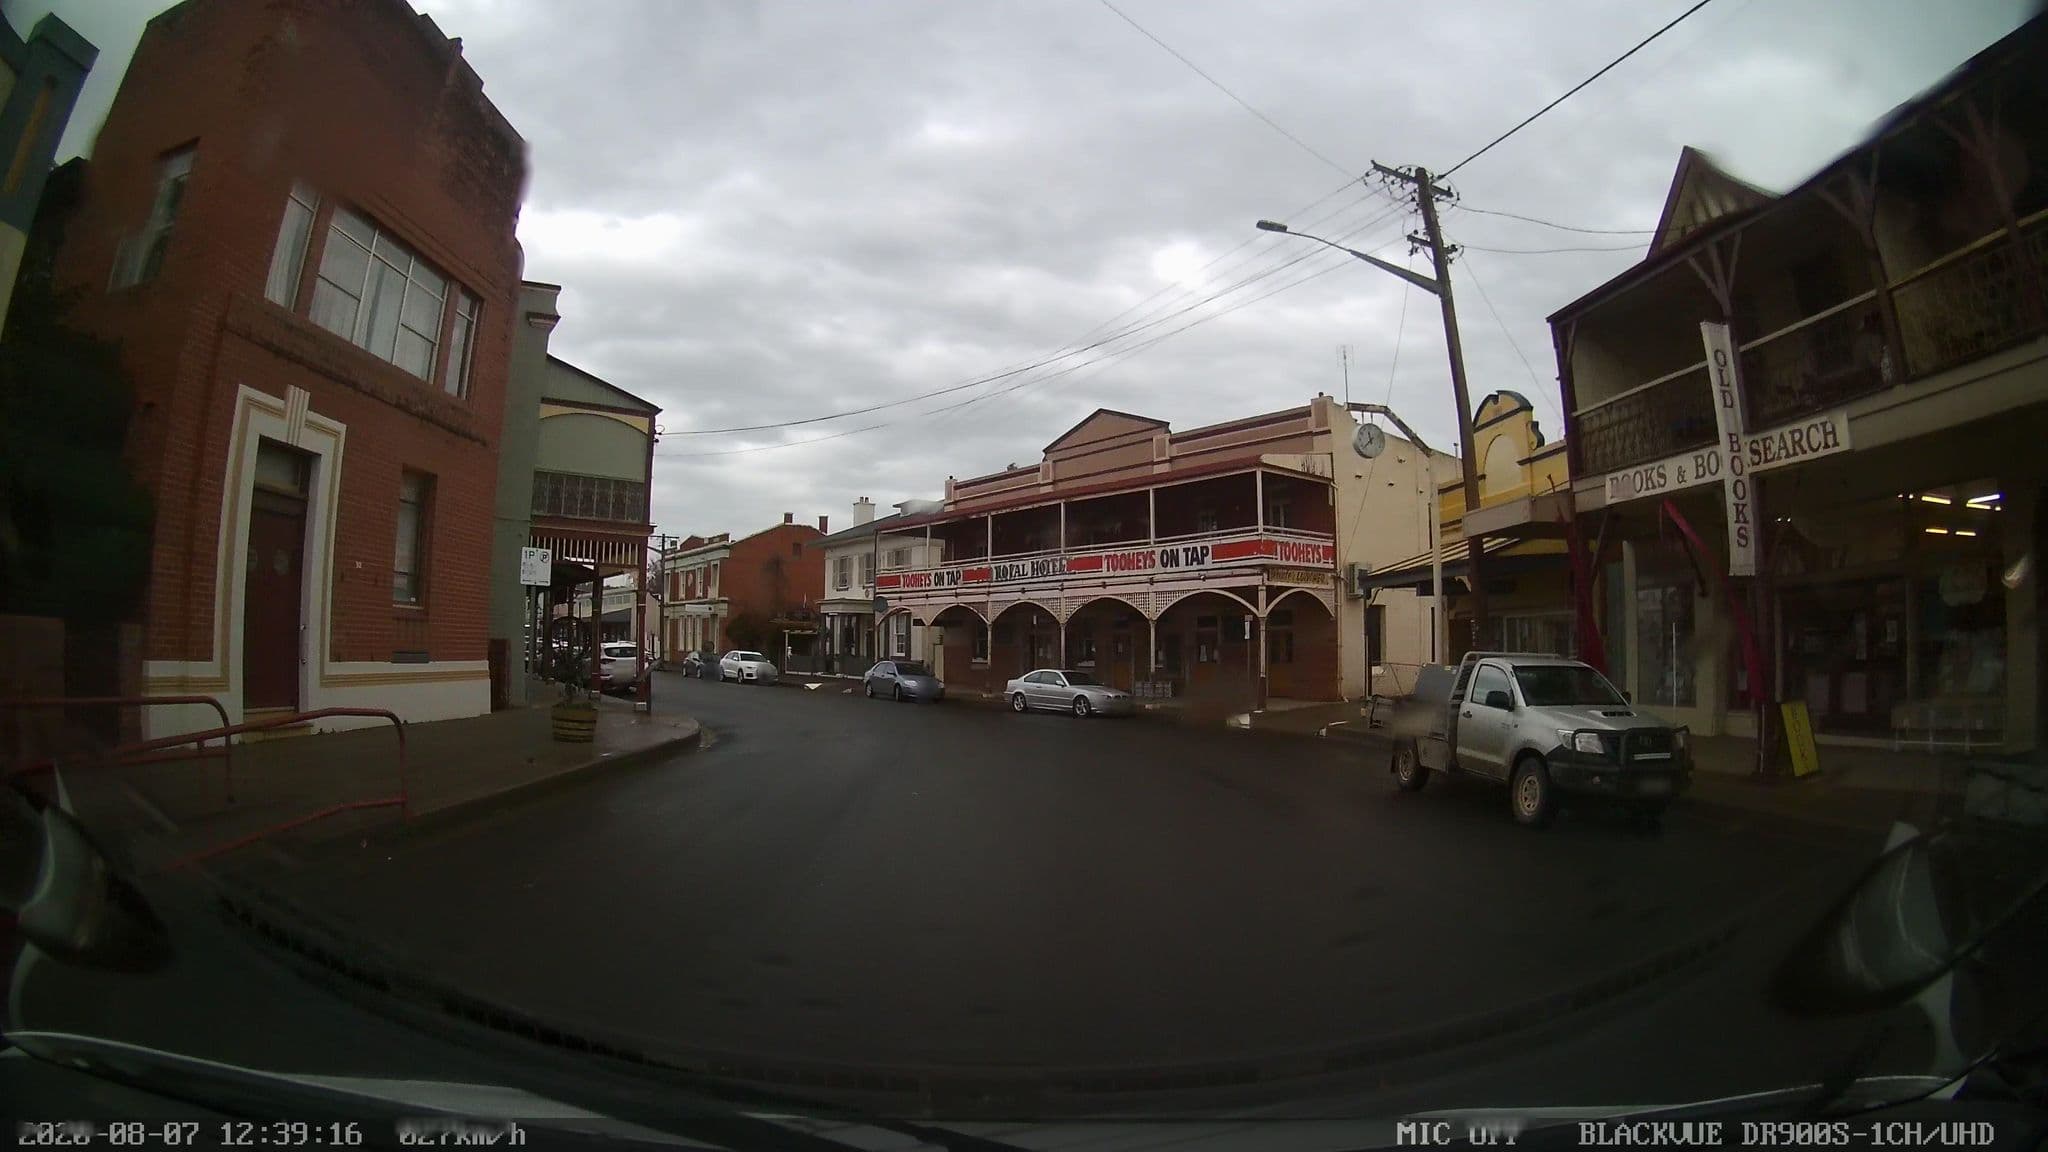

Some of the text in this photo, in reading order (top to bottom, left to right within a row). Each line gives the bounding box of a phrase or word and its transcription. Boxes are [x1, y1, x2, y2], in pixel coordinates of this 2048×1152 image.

[1713, 348, 1749, 548] OLD BOOKS
[1609, 465, 1667, 499] OKS
[1676, 465, 1687, 484] &
[1105, 545, 1209, 571] TOOHEYS ON TAP
[1279, 541, 1321, 563] TOOHEYS
[902, 569, 961, 588] TOOHEYS ON TAP
[994, 563, 1028, 580] ROYAL
